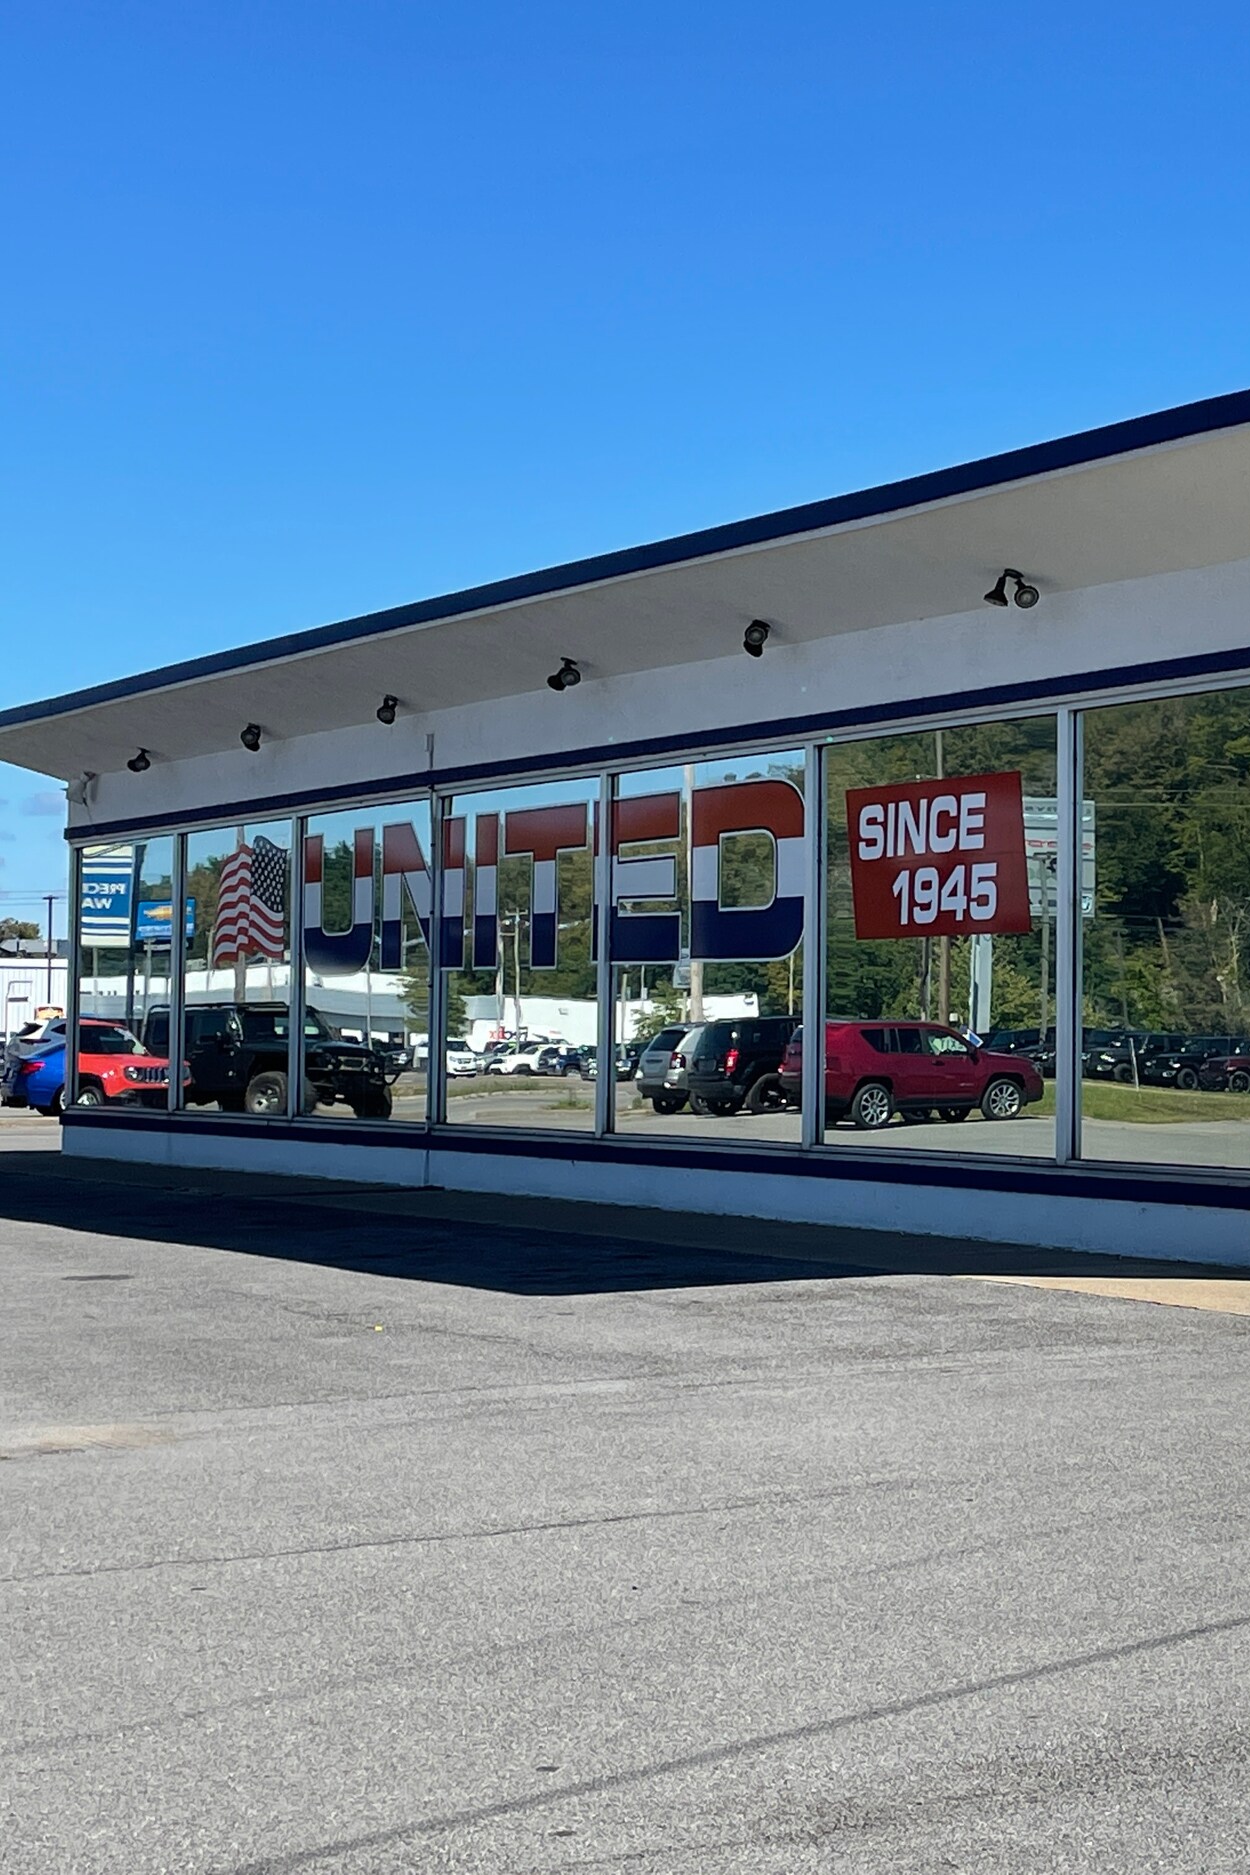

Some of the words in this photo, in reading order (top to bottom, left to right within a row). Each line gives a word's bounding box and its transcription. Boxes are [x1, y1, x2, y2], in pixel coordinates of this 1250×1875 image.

[858, 792, 987, 861] SINCE
[302, 778, 804, 977] UNITED
[892, 862, 998, 926] 1945
